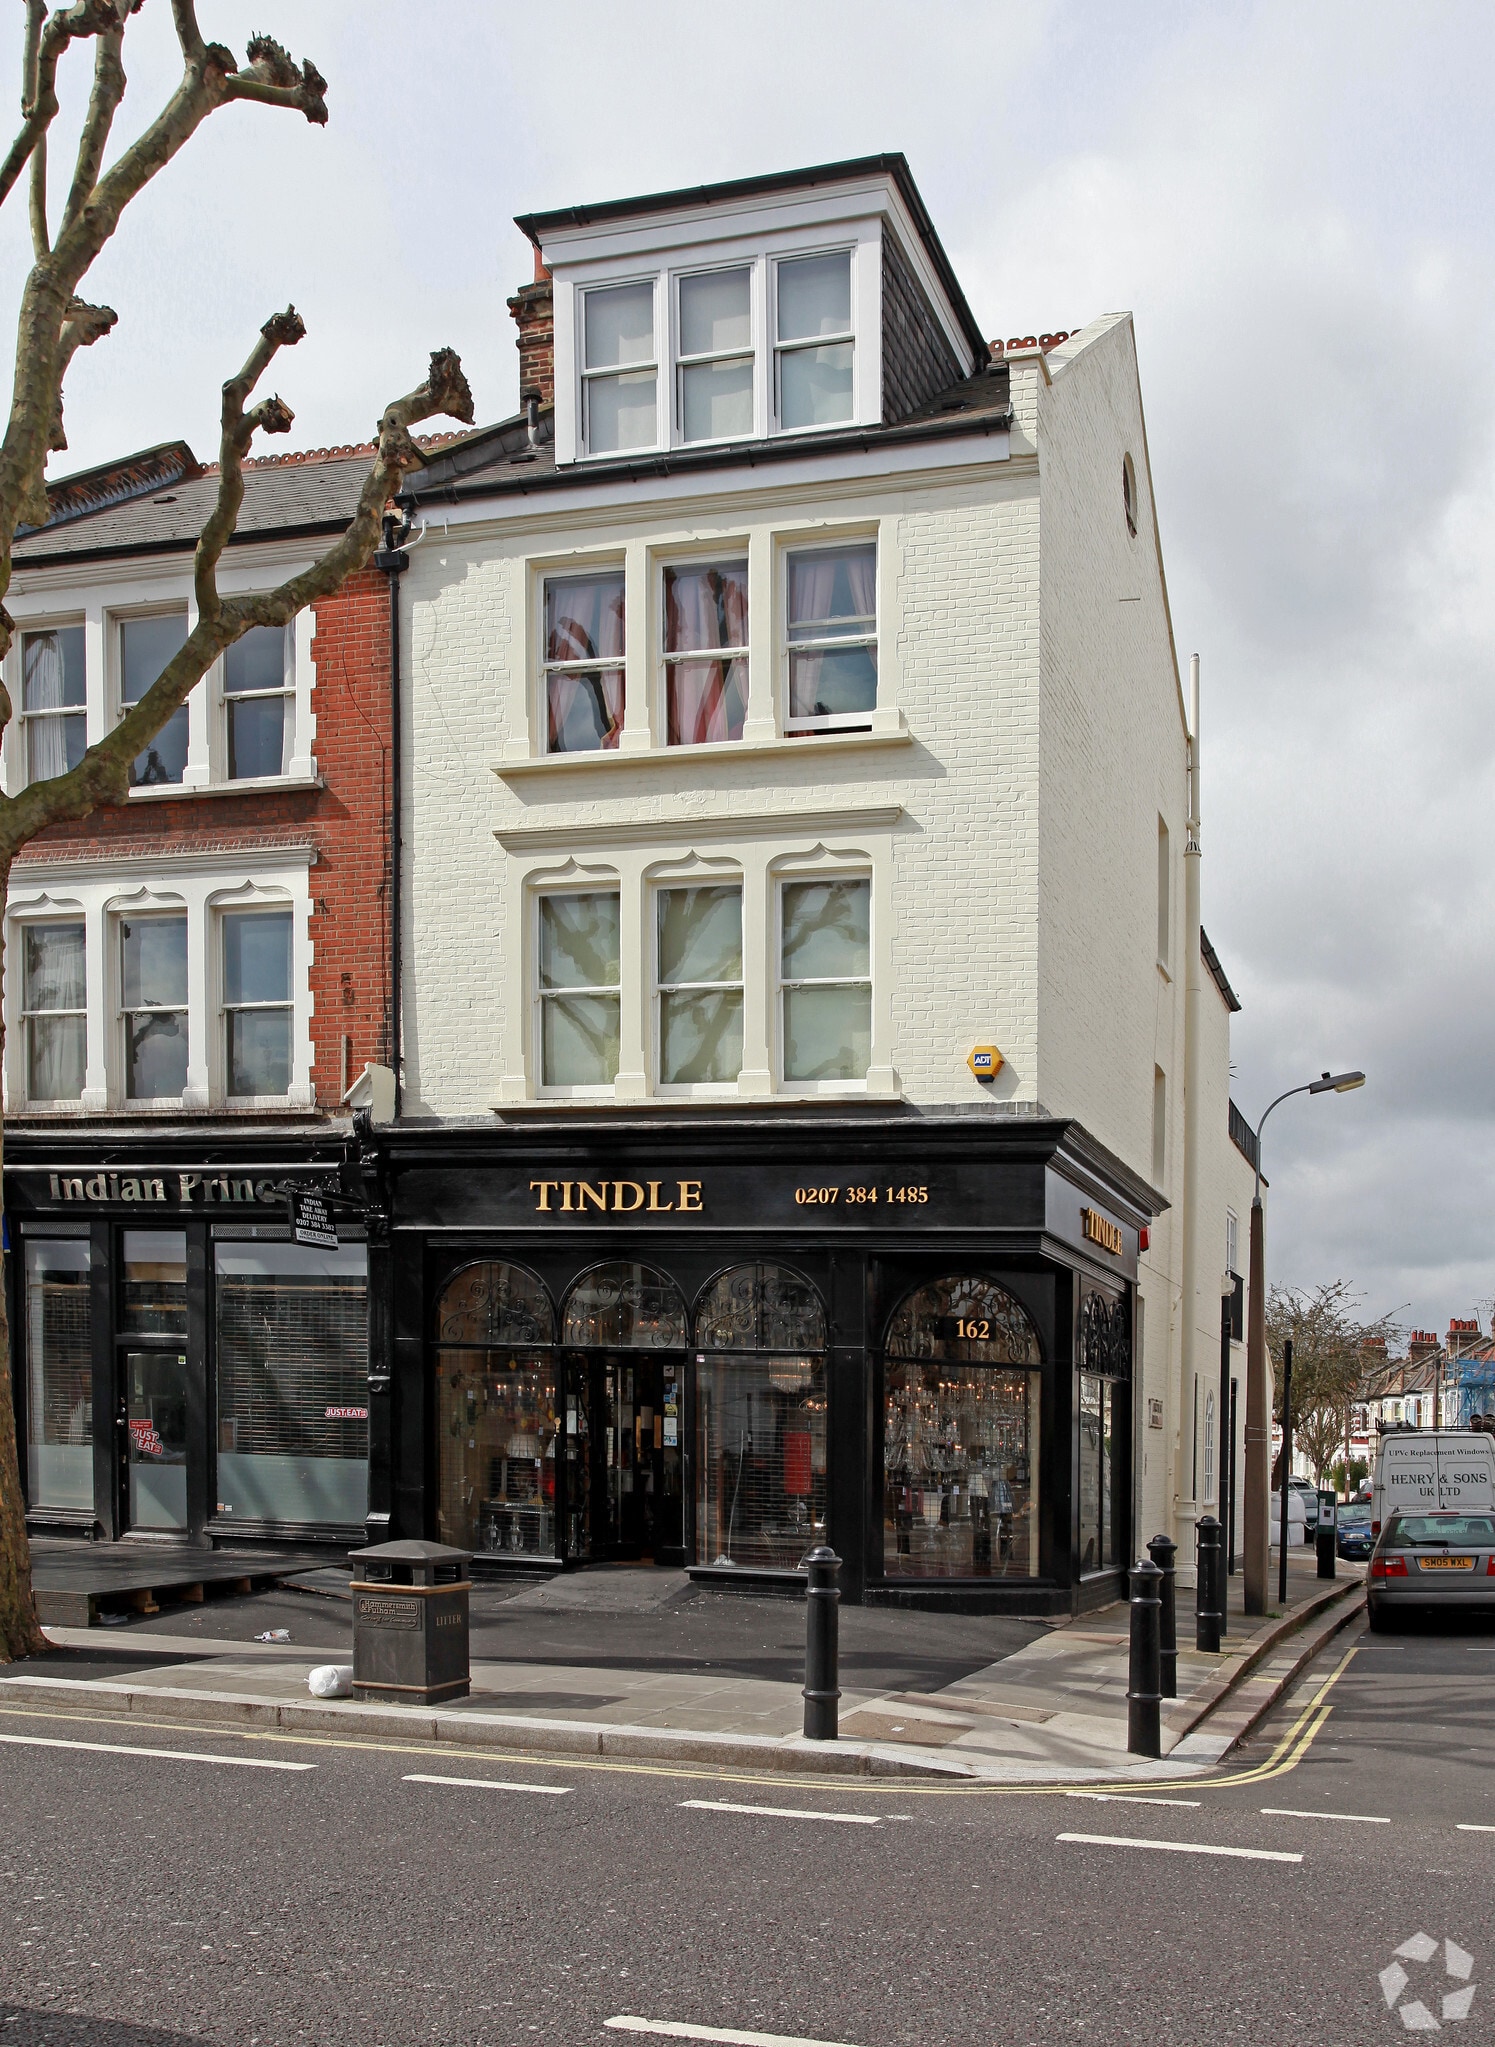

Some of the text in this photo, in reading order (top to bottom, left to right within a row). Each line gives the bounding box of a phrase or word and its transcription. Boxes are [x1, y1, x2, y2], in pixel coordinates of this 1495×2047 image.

[975, 1055, 991, 1064] ADT
[49, 1173, 167, 1201] Indian
[530, 1180, 704, 1212] TINDLE
[794, 1186, 929, 1204] 0207 384 1485
[304, 1198, 322, 1207] INDIAN
[300, 1204, 327, 1216] TAKE AWAY
[296, 1218, 309, 1226] 0207
[302, 1212, 327, 1222] DELIVERY
[1087, 1207, 1123, 1256] TINDLE
[956, 1319, 990, 1339] 162
[326, 1408, 346, 1416] JUST
[346, 1409, 361, 1417] EAT
[133, 1428, 158, 1442] JUST
[137, 1438, 156, 1451] EAT
[1410, 1449, 1455, 1457] Replacement
[1456, 1448, 1490, 1456] Windows
[1391, 1472, 1488, 1485] HENRY & SONS
[1419, 1487, 1461, 1497] UK LTD
[1424, 1558, 1468, 1567] SM05 WXL
[365, 1600, 416, 1610] Hammersmith
[367, 1606, 396, 1615] Fulham
[436, 1614, 462, 1627] LITTER
